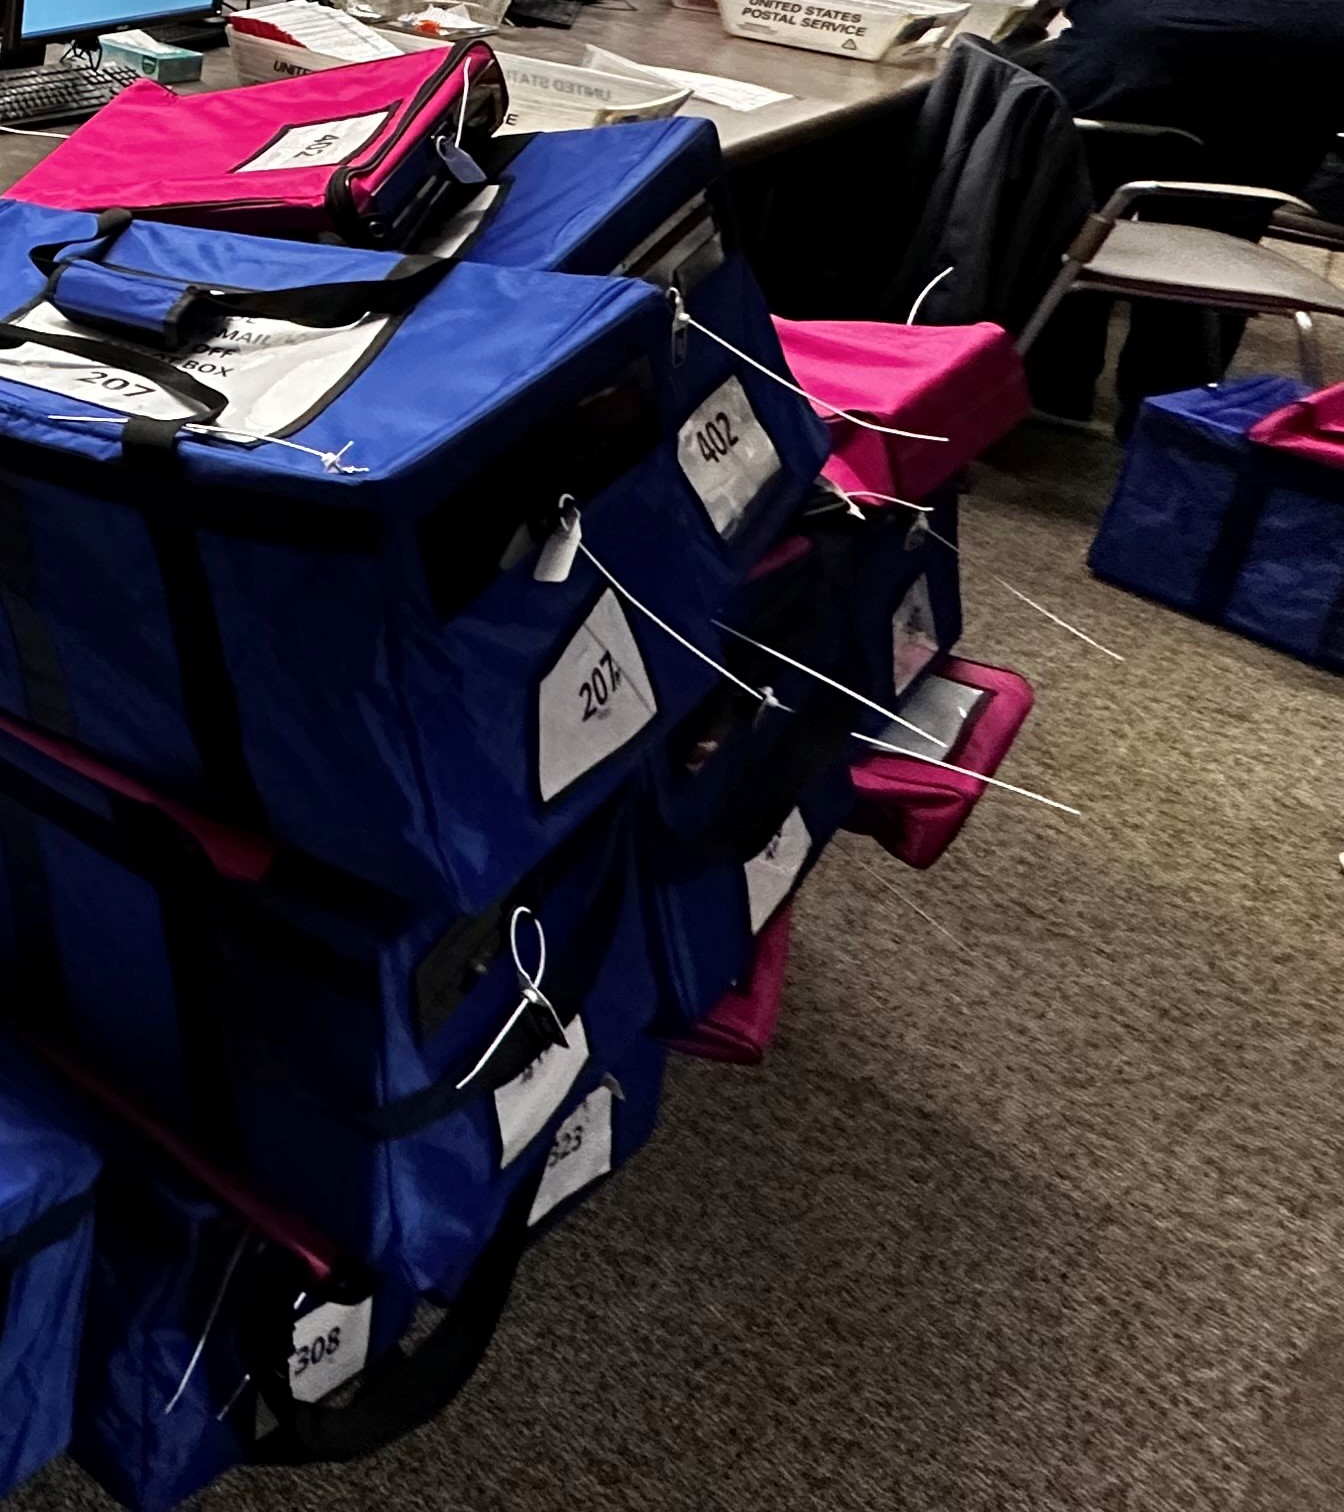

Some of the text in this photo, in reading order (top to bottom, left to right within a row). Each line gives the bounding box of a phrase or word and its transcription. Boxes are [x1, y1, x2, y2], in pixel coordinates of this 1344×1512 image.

[742, 7, 796, 26] POSTAL
[800, 17, 869, 38] SERVICE
[804, 6, 862, 24] STATES
[293, 134, 340, 158] 402
[194, 342, 238, 359] OFF
[182, 359, 236, 378] BOX
[76, 370, 156, 399] 207
[697, 412, 740, 463] 402
[579, 649, 618, 722] 207
[293, 1325, 342, 1377] 308
